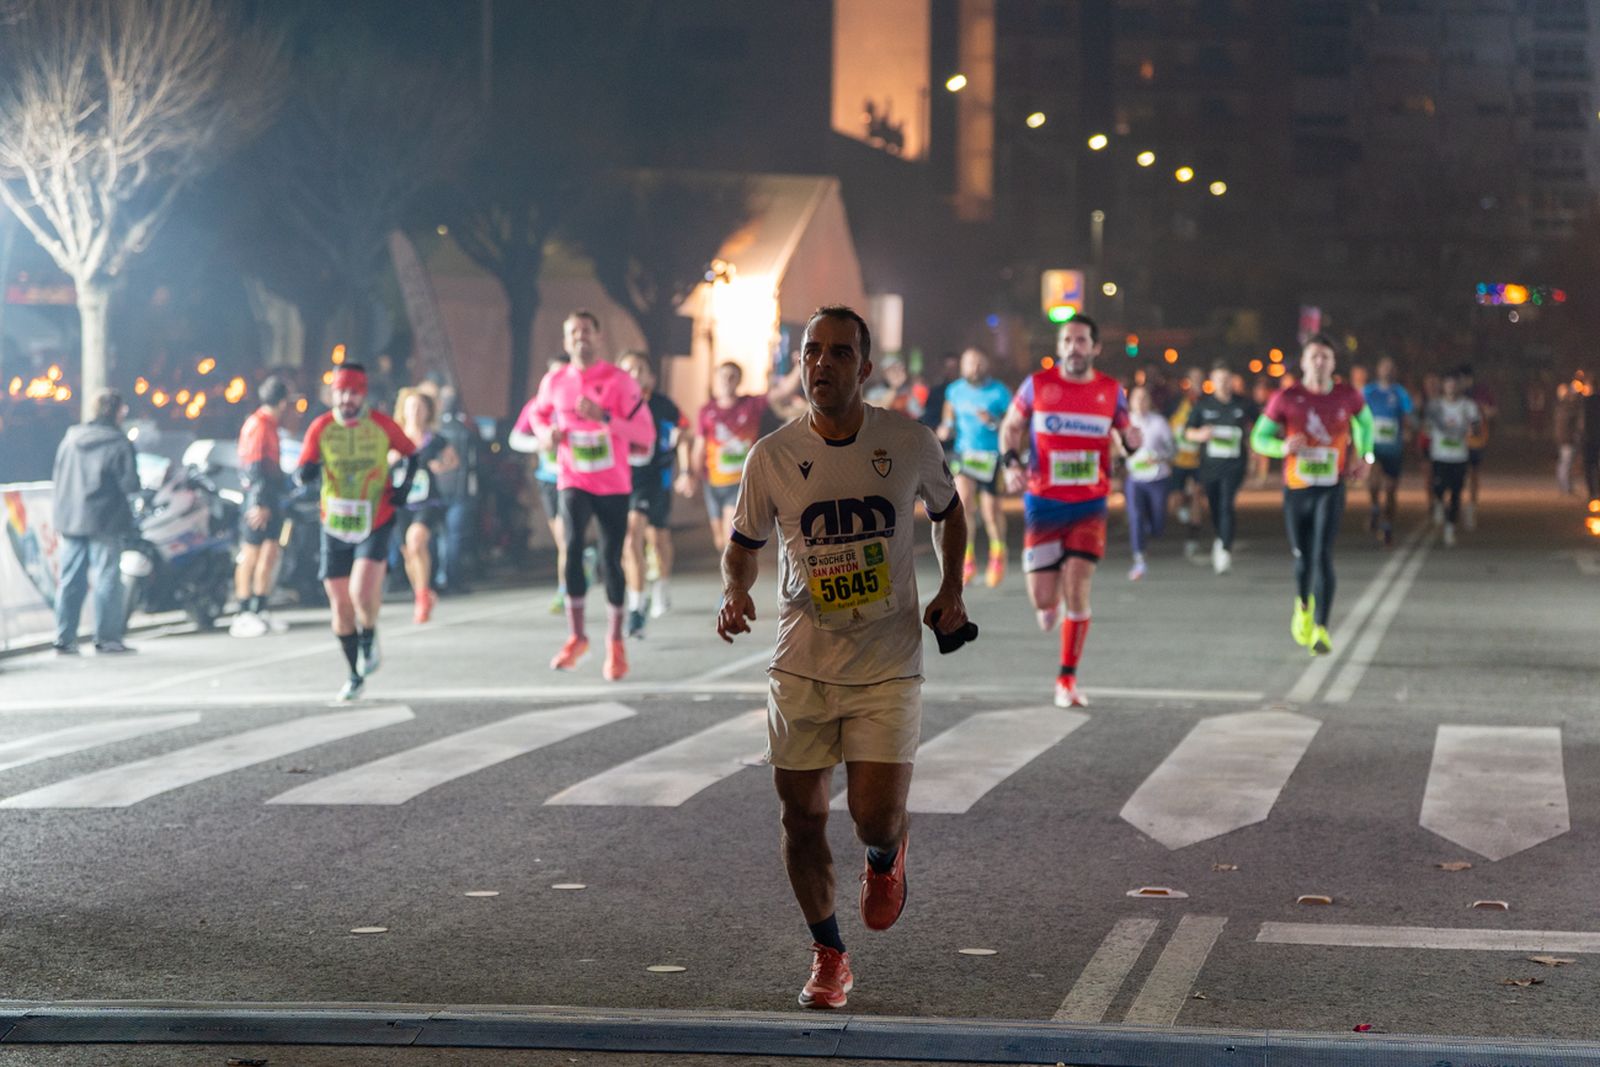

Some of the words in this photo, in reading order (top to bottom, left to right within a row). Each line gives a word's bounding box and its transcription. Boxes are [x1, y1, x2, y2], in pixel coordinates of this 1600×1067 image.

[818, 554, 844, 566] NOCHE
[845, 552, 857, 562] DE
[812, 565, 828, 578] SAN
[820, 568, 879, 603] 5645
